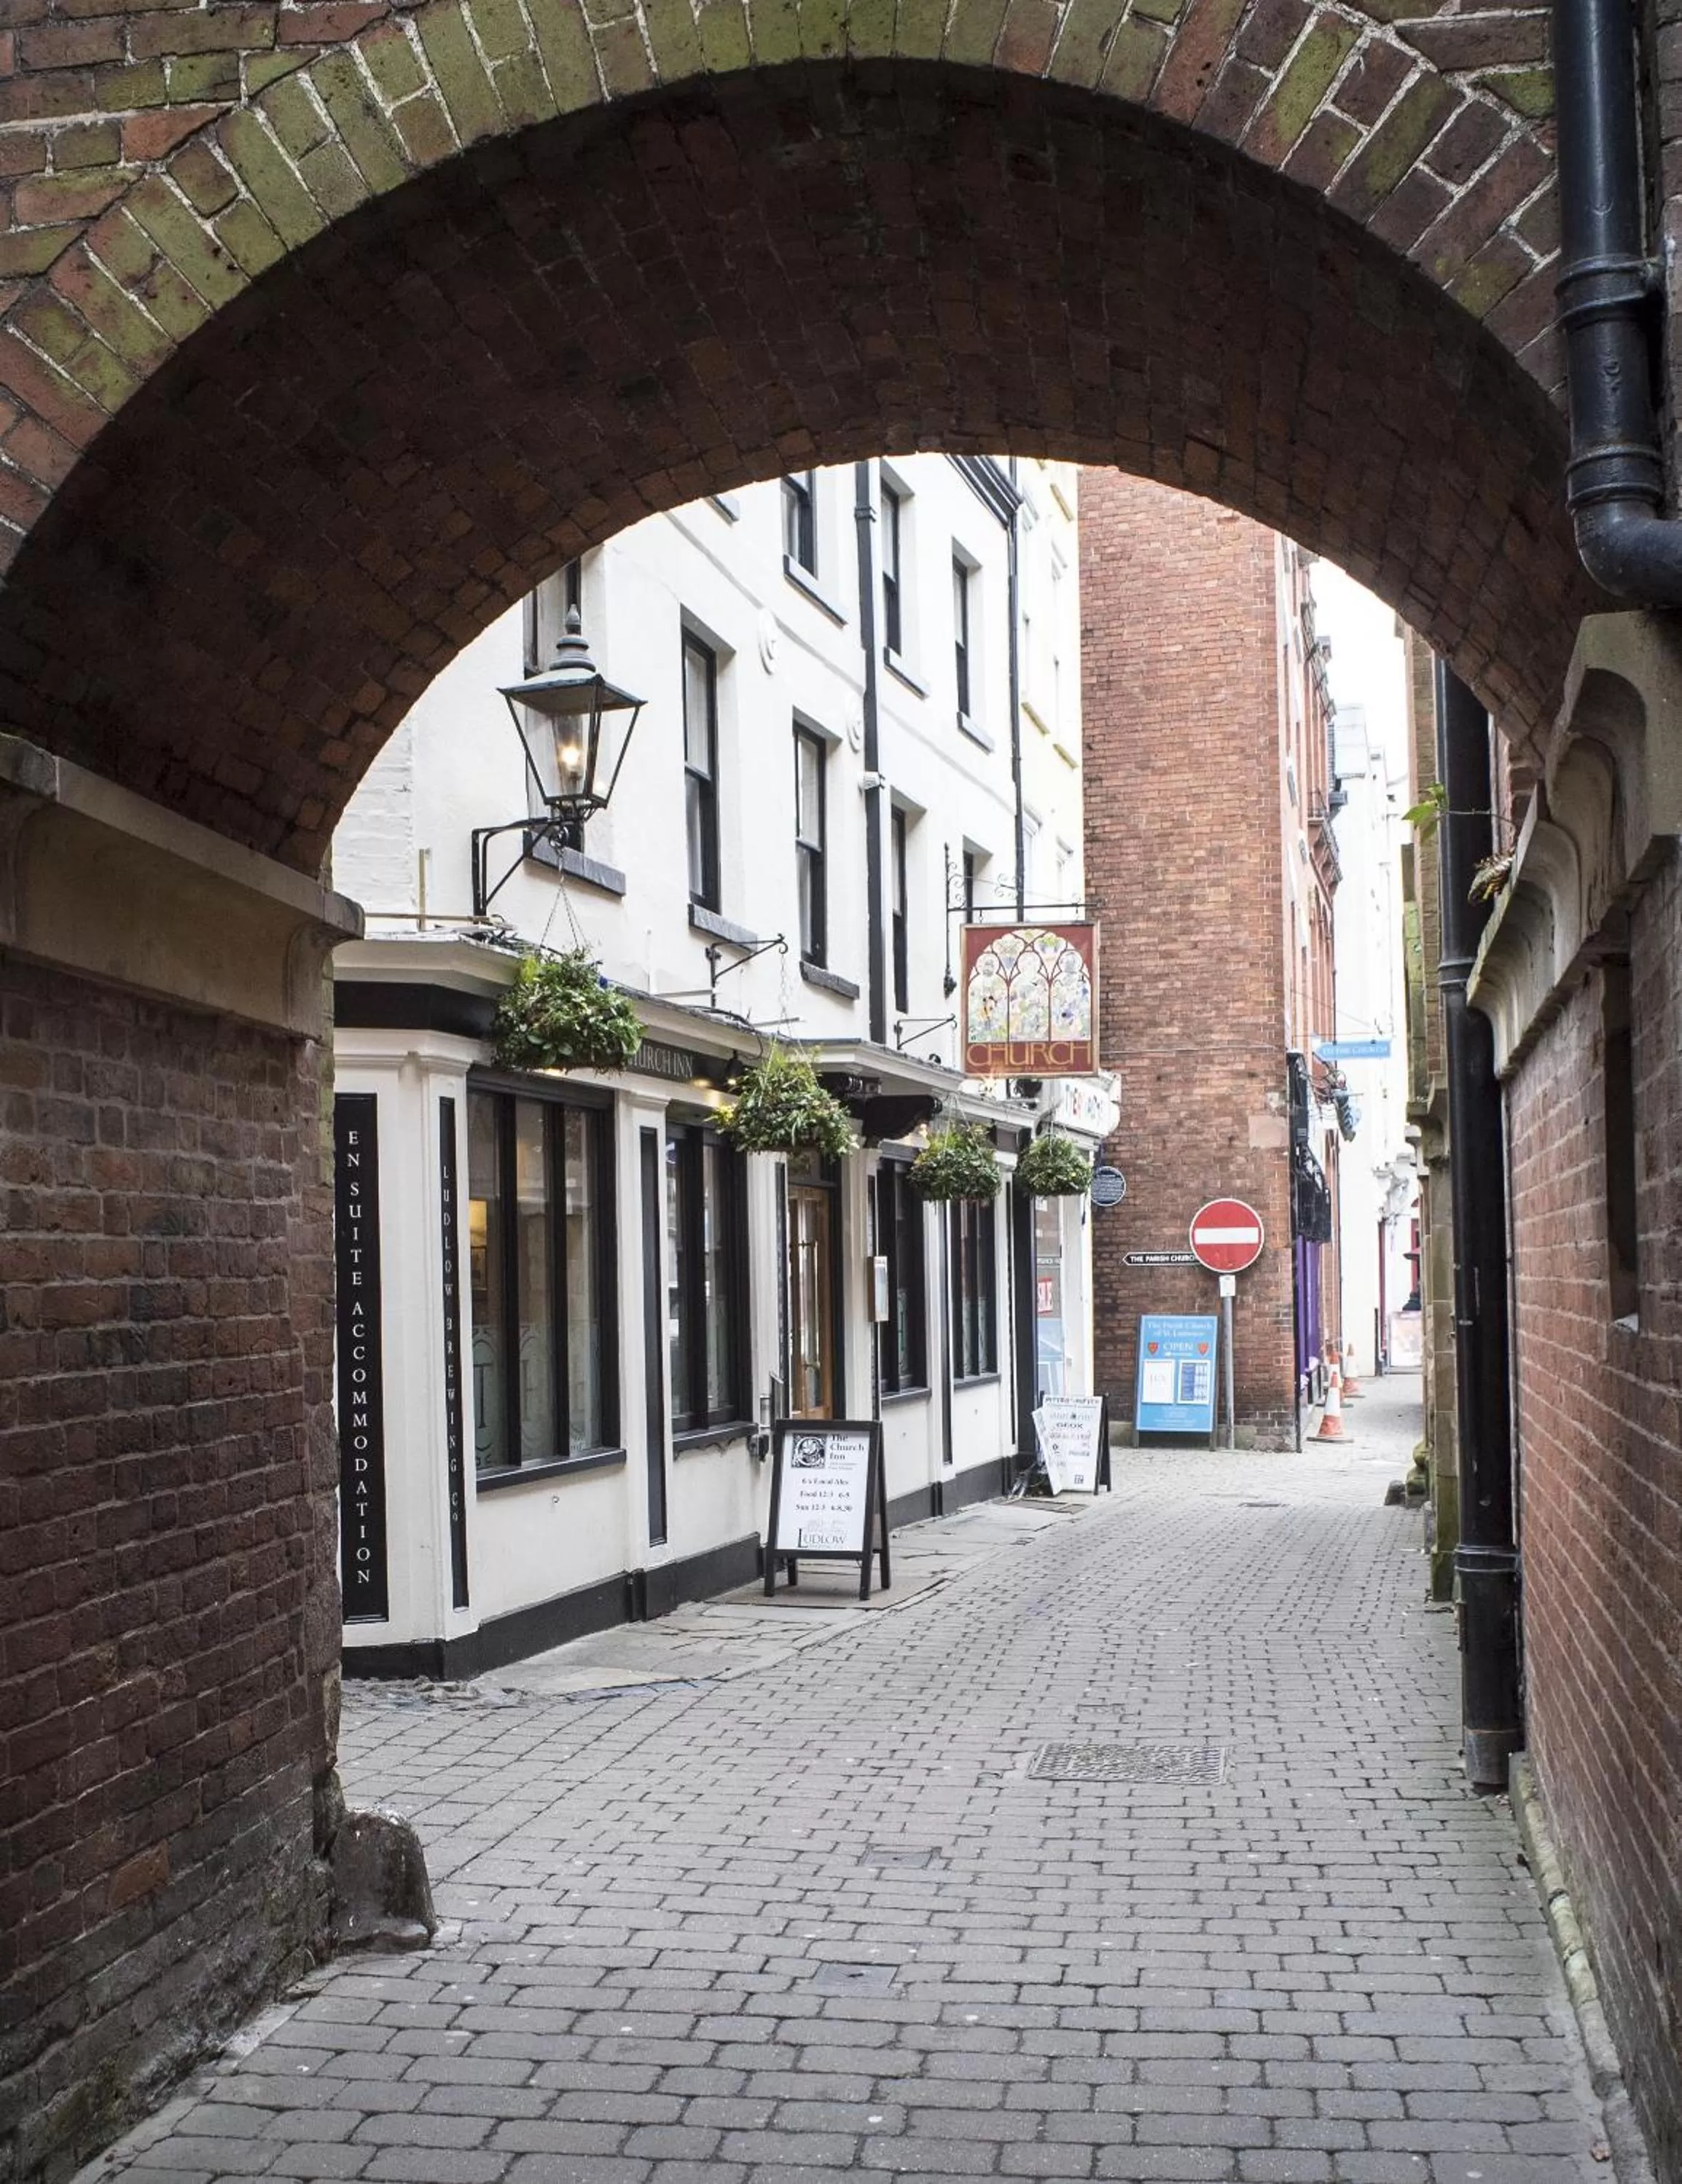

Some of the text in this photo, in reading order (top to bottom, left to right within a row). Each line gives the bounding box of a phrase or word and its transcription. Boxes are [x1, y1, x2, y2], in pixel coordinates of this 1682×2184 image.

[966, 1041, 1092, 1067] CHURCH
[673, 1052, 693, 1079] INN
[443, 1165, 454, 1296] LUDLOW
[1145, 1255, 1170, 1263] PARISH
[1170, 1254, 1195, 1262] CHURC
[1163, 1342, 1193, 1351] OPEN
[445, 1317, 458, 1473] BREWING
[351, 1302, 371, 1584] ACCOMMODATION
[831, 1433, 849, 1442] The
[829, 1443, 865, 1452] Church
[829, 1452, 846, 1460] Inn
